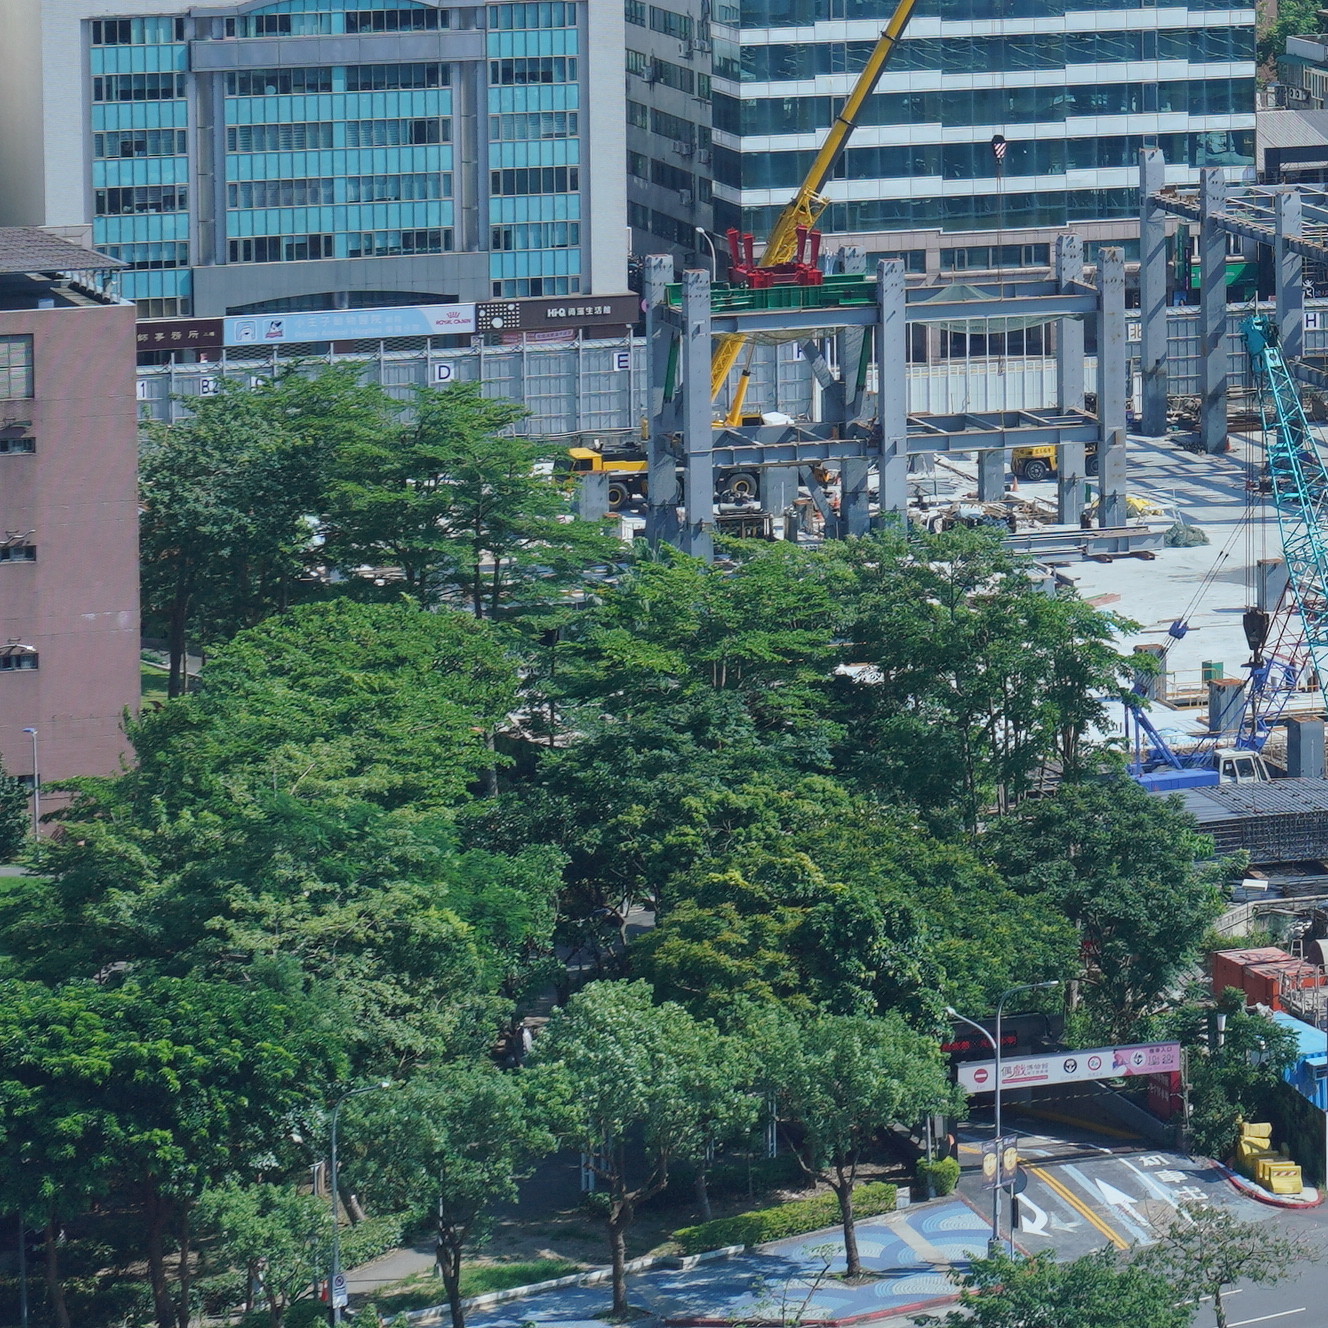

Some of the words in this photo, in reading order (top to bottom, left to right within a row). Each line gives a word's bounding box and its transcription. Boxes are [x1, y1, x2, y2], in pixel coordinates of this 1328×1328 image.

[1305, 313, 1317, 328] H
[617, 354, 629, 369] E
[438, 365, 451, 380] D
